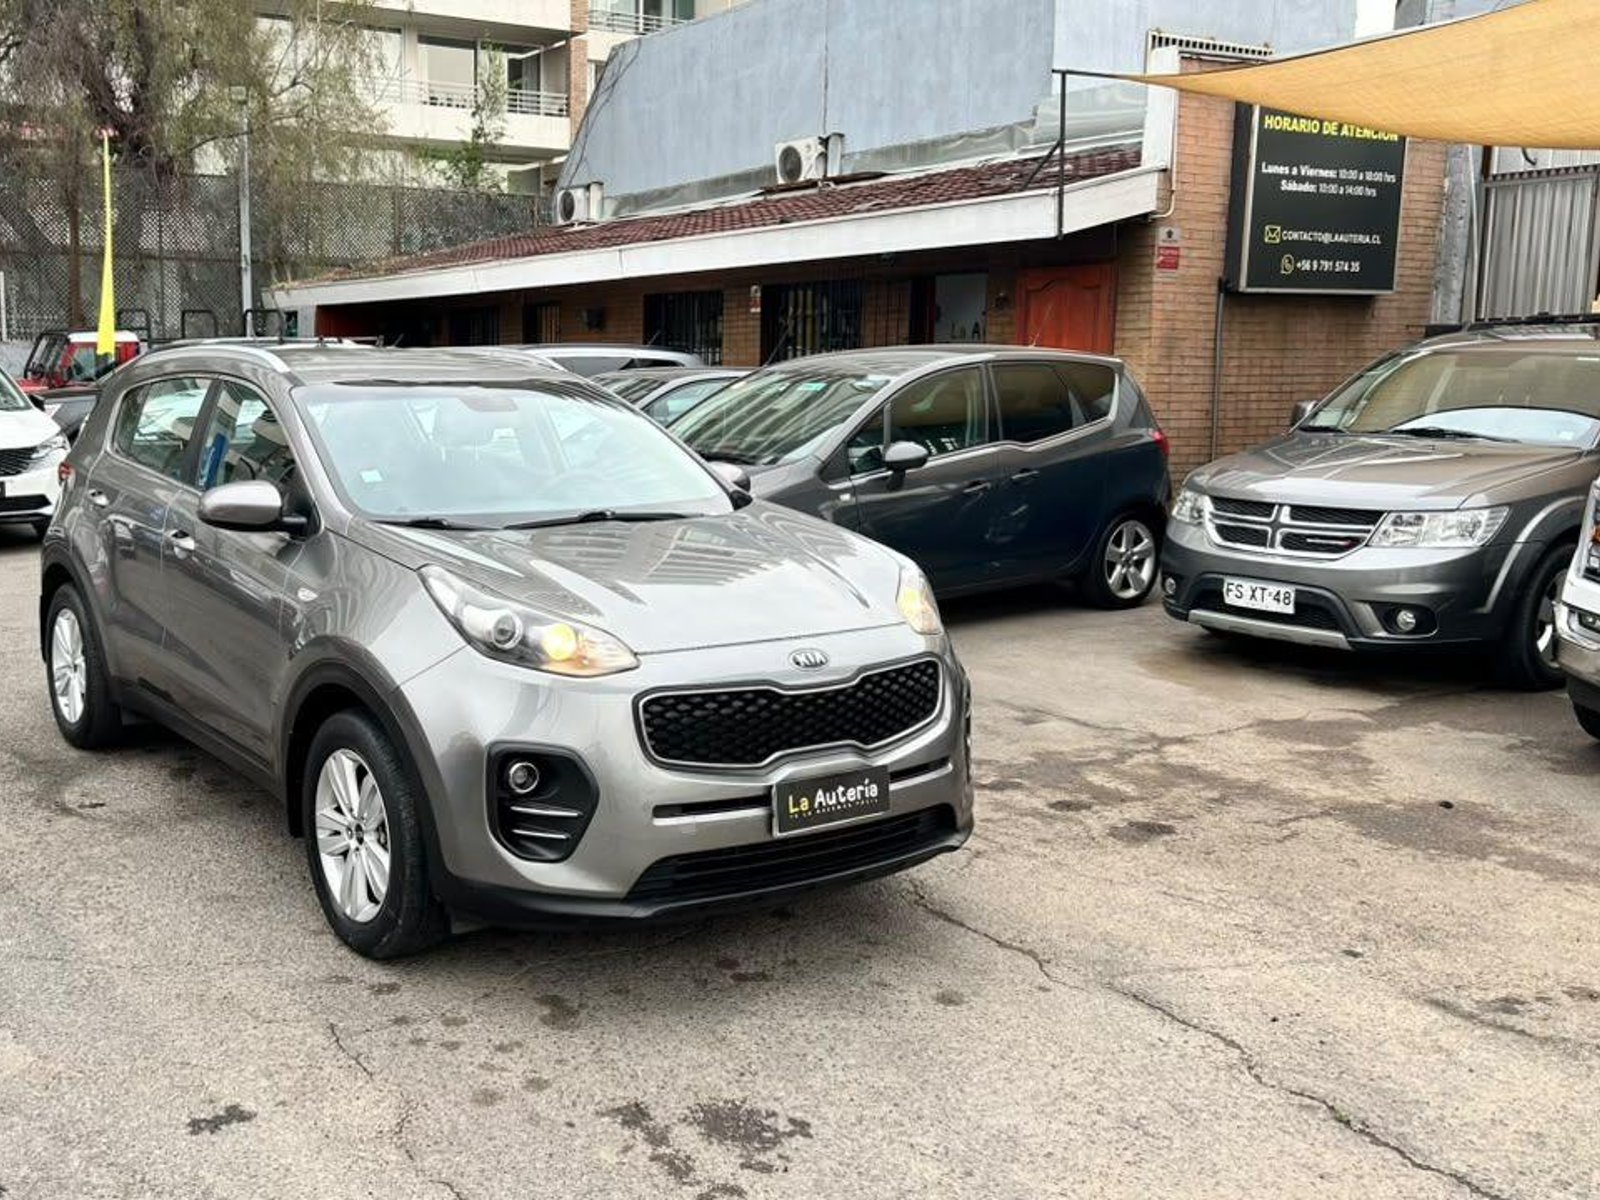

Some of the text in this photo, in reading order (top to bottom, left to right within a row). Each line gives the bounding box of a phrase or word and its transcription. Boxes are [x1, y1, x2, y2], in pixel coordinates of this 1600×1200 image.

[1264, 115, 1320, 134] HORARIO
[1322, 121, 1339, 135] DE
[1261, 161, 1290, 175] Lunes
[1291, 165, 1298, 175] a
[1300, 164, 1338, 178] Viernes:
[1383, 172, 1396, 183] hrs
[1280, 180, 1318, 193] Sábado:
[1364, 186, 1377, 198] hrs
[1226, 582, 1243, 599] FS
[787, 794, 809, 814] La
